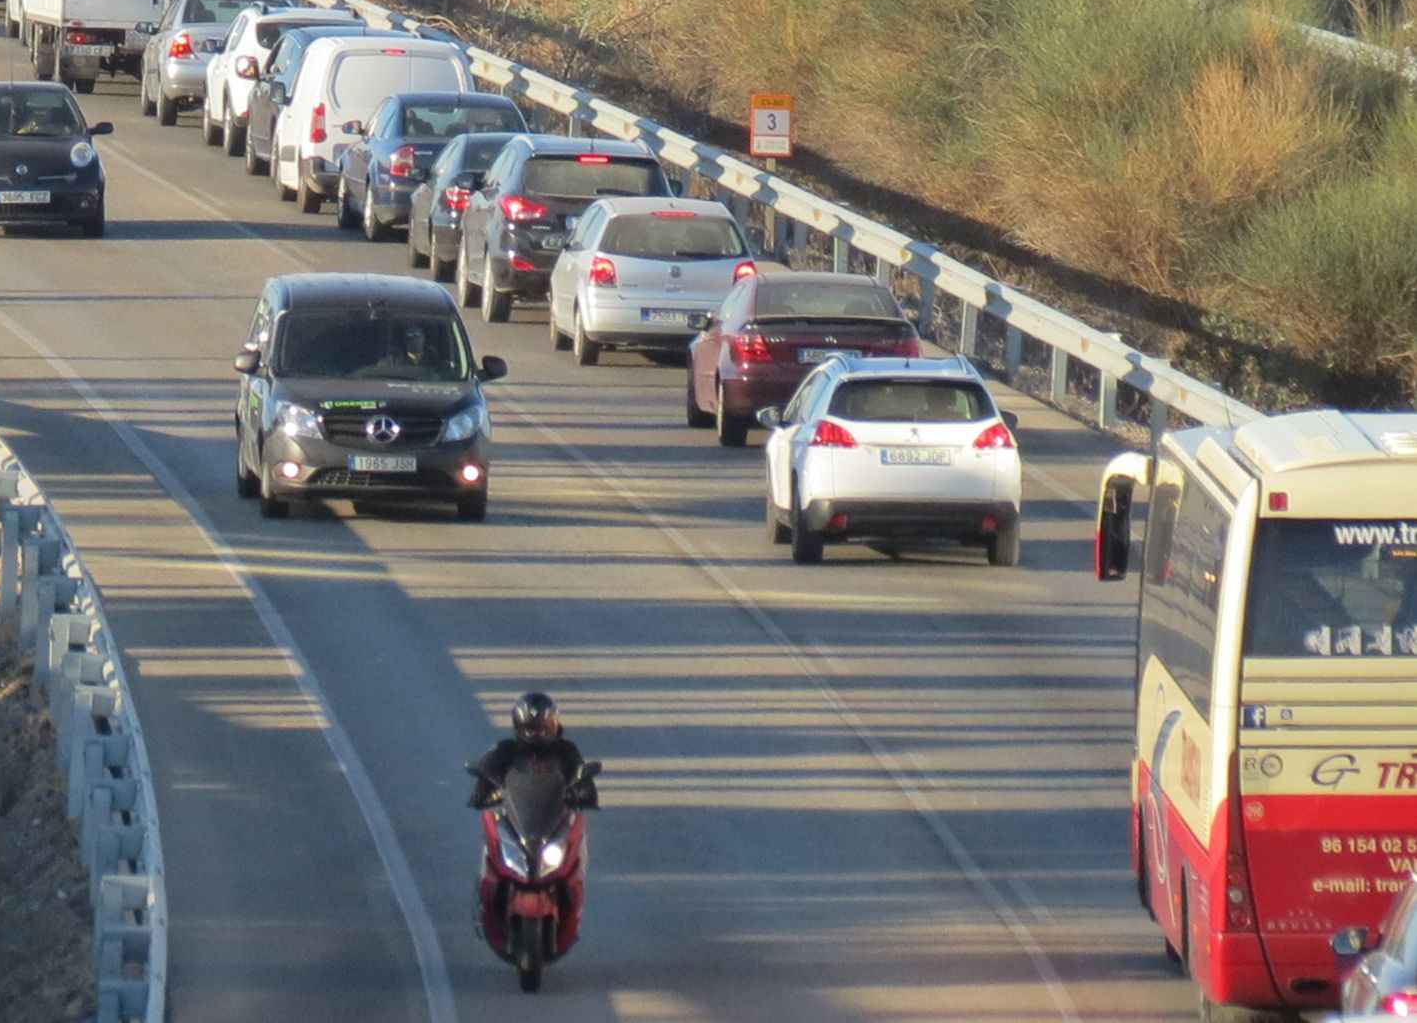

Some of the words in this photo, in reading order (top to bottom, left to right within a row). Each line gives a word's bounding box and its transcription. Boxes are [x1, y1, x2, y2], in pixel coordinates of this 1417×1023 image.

[766, 112, 777, 131] 3
[1321, 837, 1343, 854] 96
[1348, 837, 1377, 854] 154
[1381, 837, 1403, 854] 02
[1313, 878, 1371, 893] e-mail:
